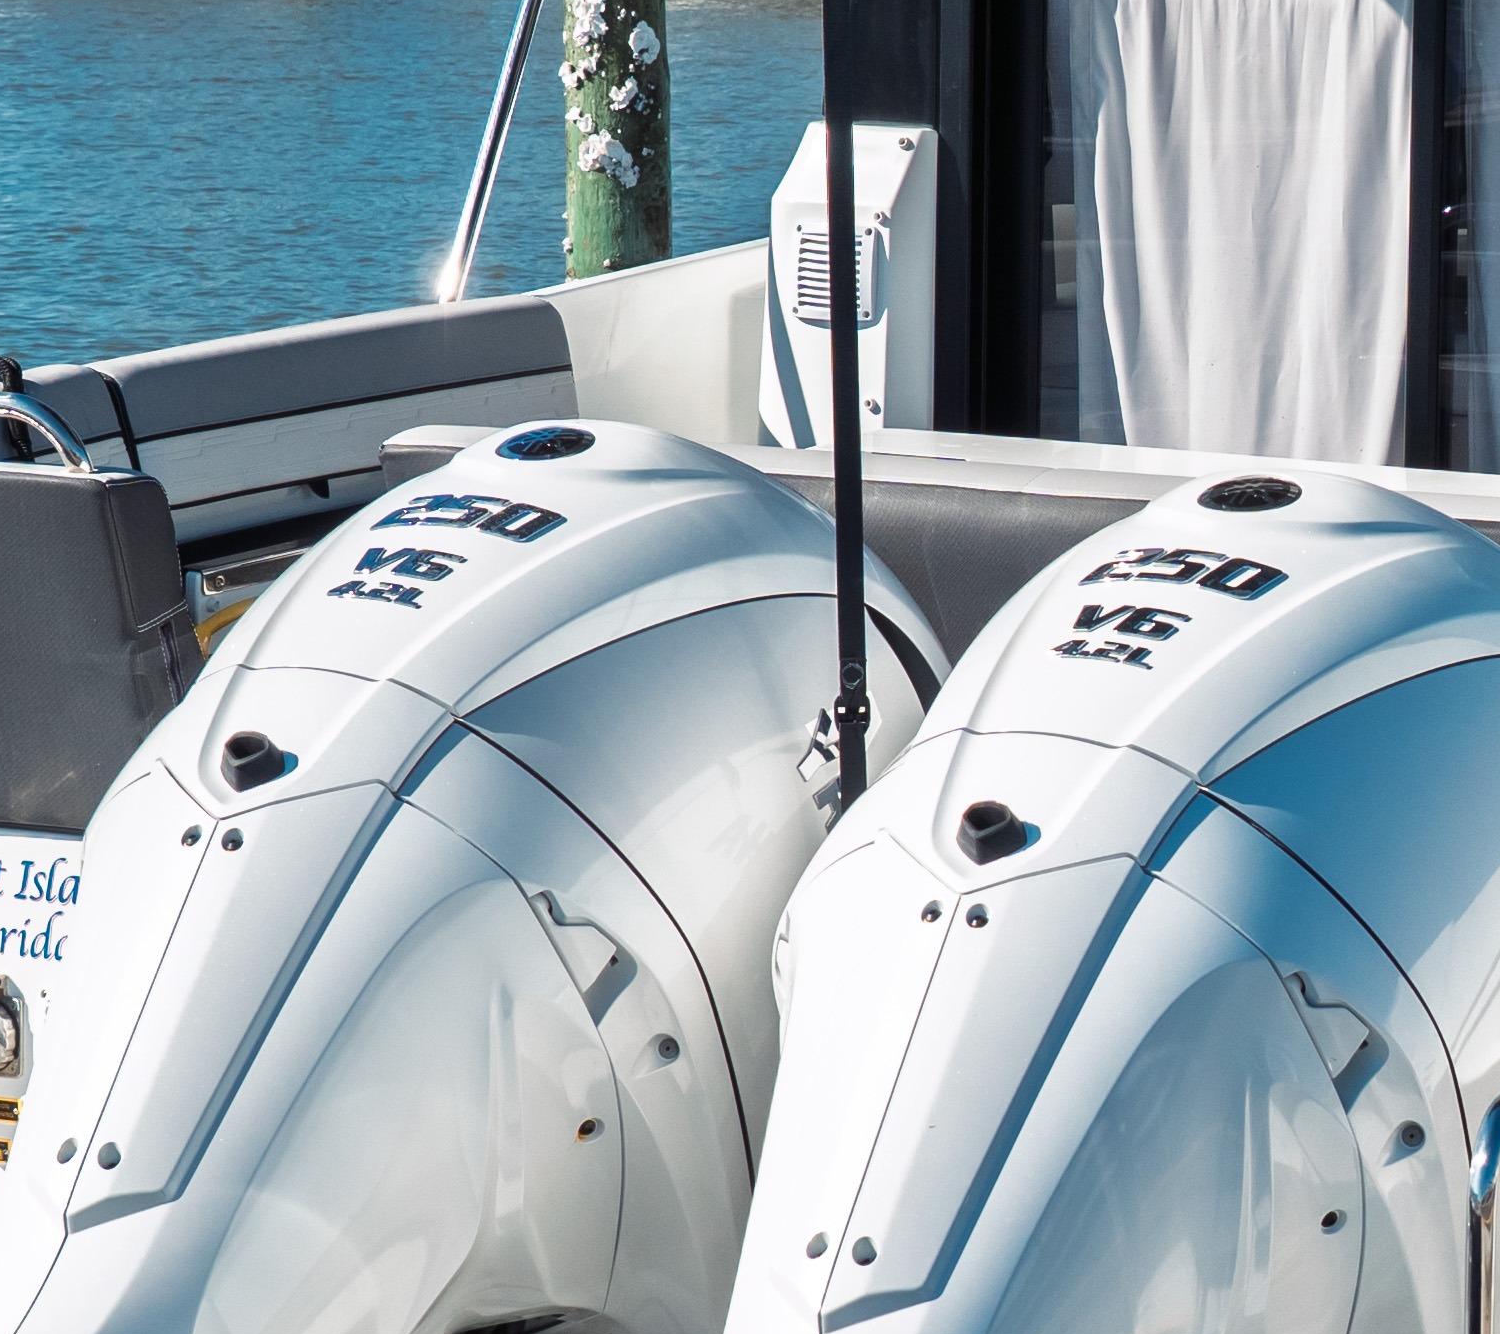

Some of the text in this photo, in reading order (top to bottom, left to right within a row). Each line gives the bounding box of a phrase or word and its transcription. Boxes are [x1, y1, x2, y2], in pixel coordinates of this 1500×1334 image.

[369, 493, 568, 543] 250
[353, 547, 468, 581] V6
[1078, 548, 1289, 601] 250
[326, 580, 424, 609] 4.2L
[1073, 605, 1193, 641] V6
[1050, 639, 1154, 670] 4.2L
